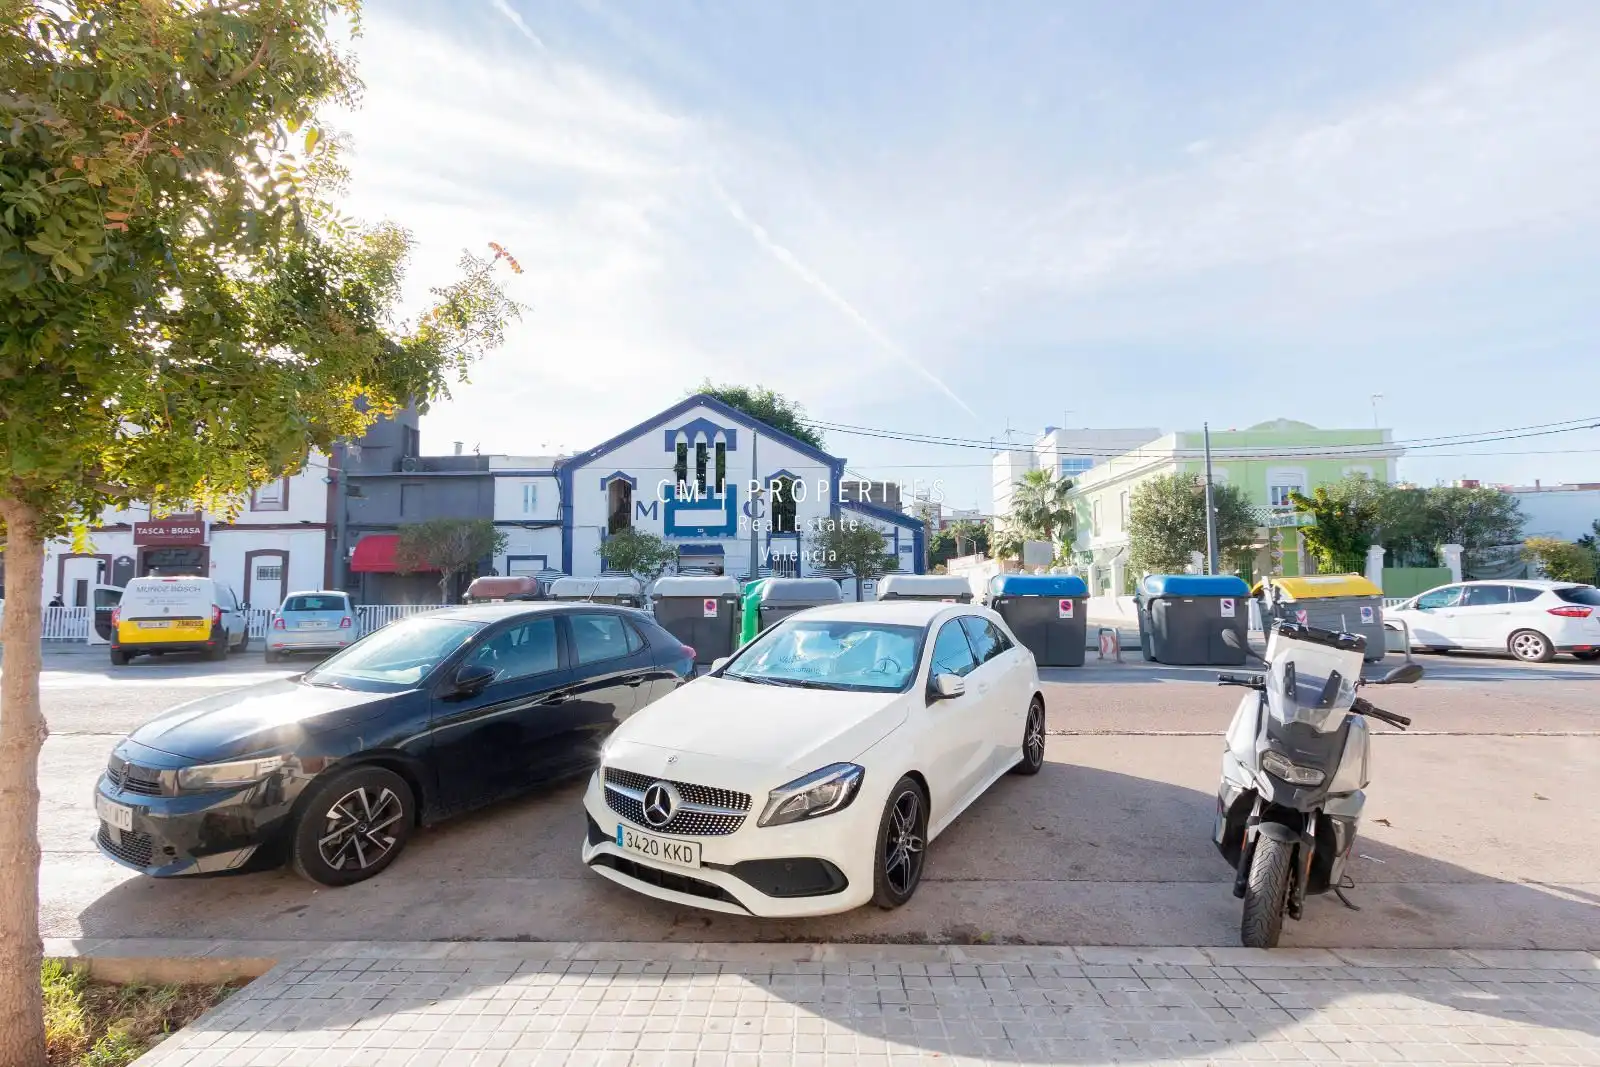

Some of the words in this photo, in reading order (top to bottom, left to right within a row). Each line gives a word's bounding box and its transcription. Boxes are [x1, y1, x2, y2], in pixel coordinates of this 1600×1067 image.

[635, 500, 658, 521] M
[742, 498, 766, 519] C
[626, 831, 659, 856] 3420
[663, 842, 693, 863] KKD
